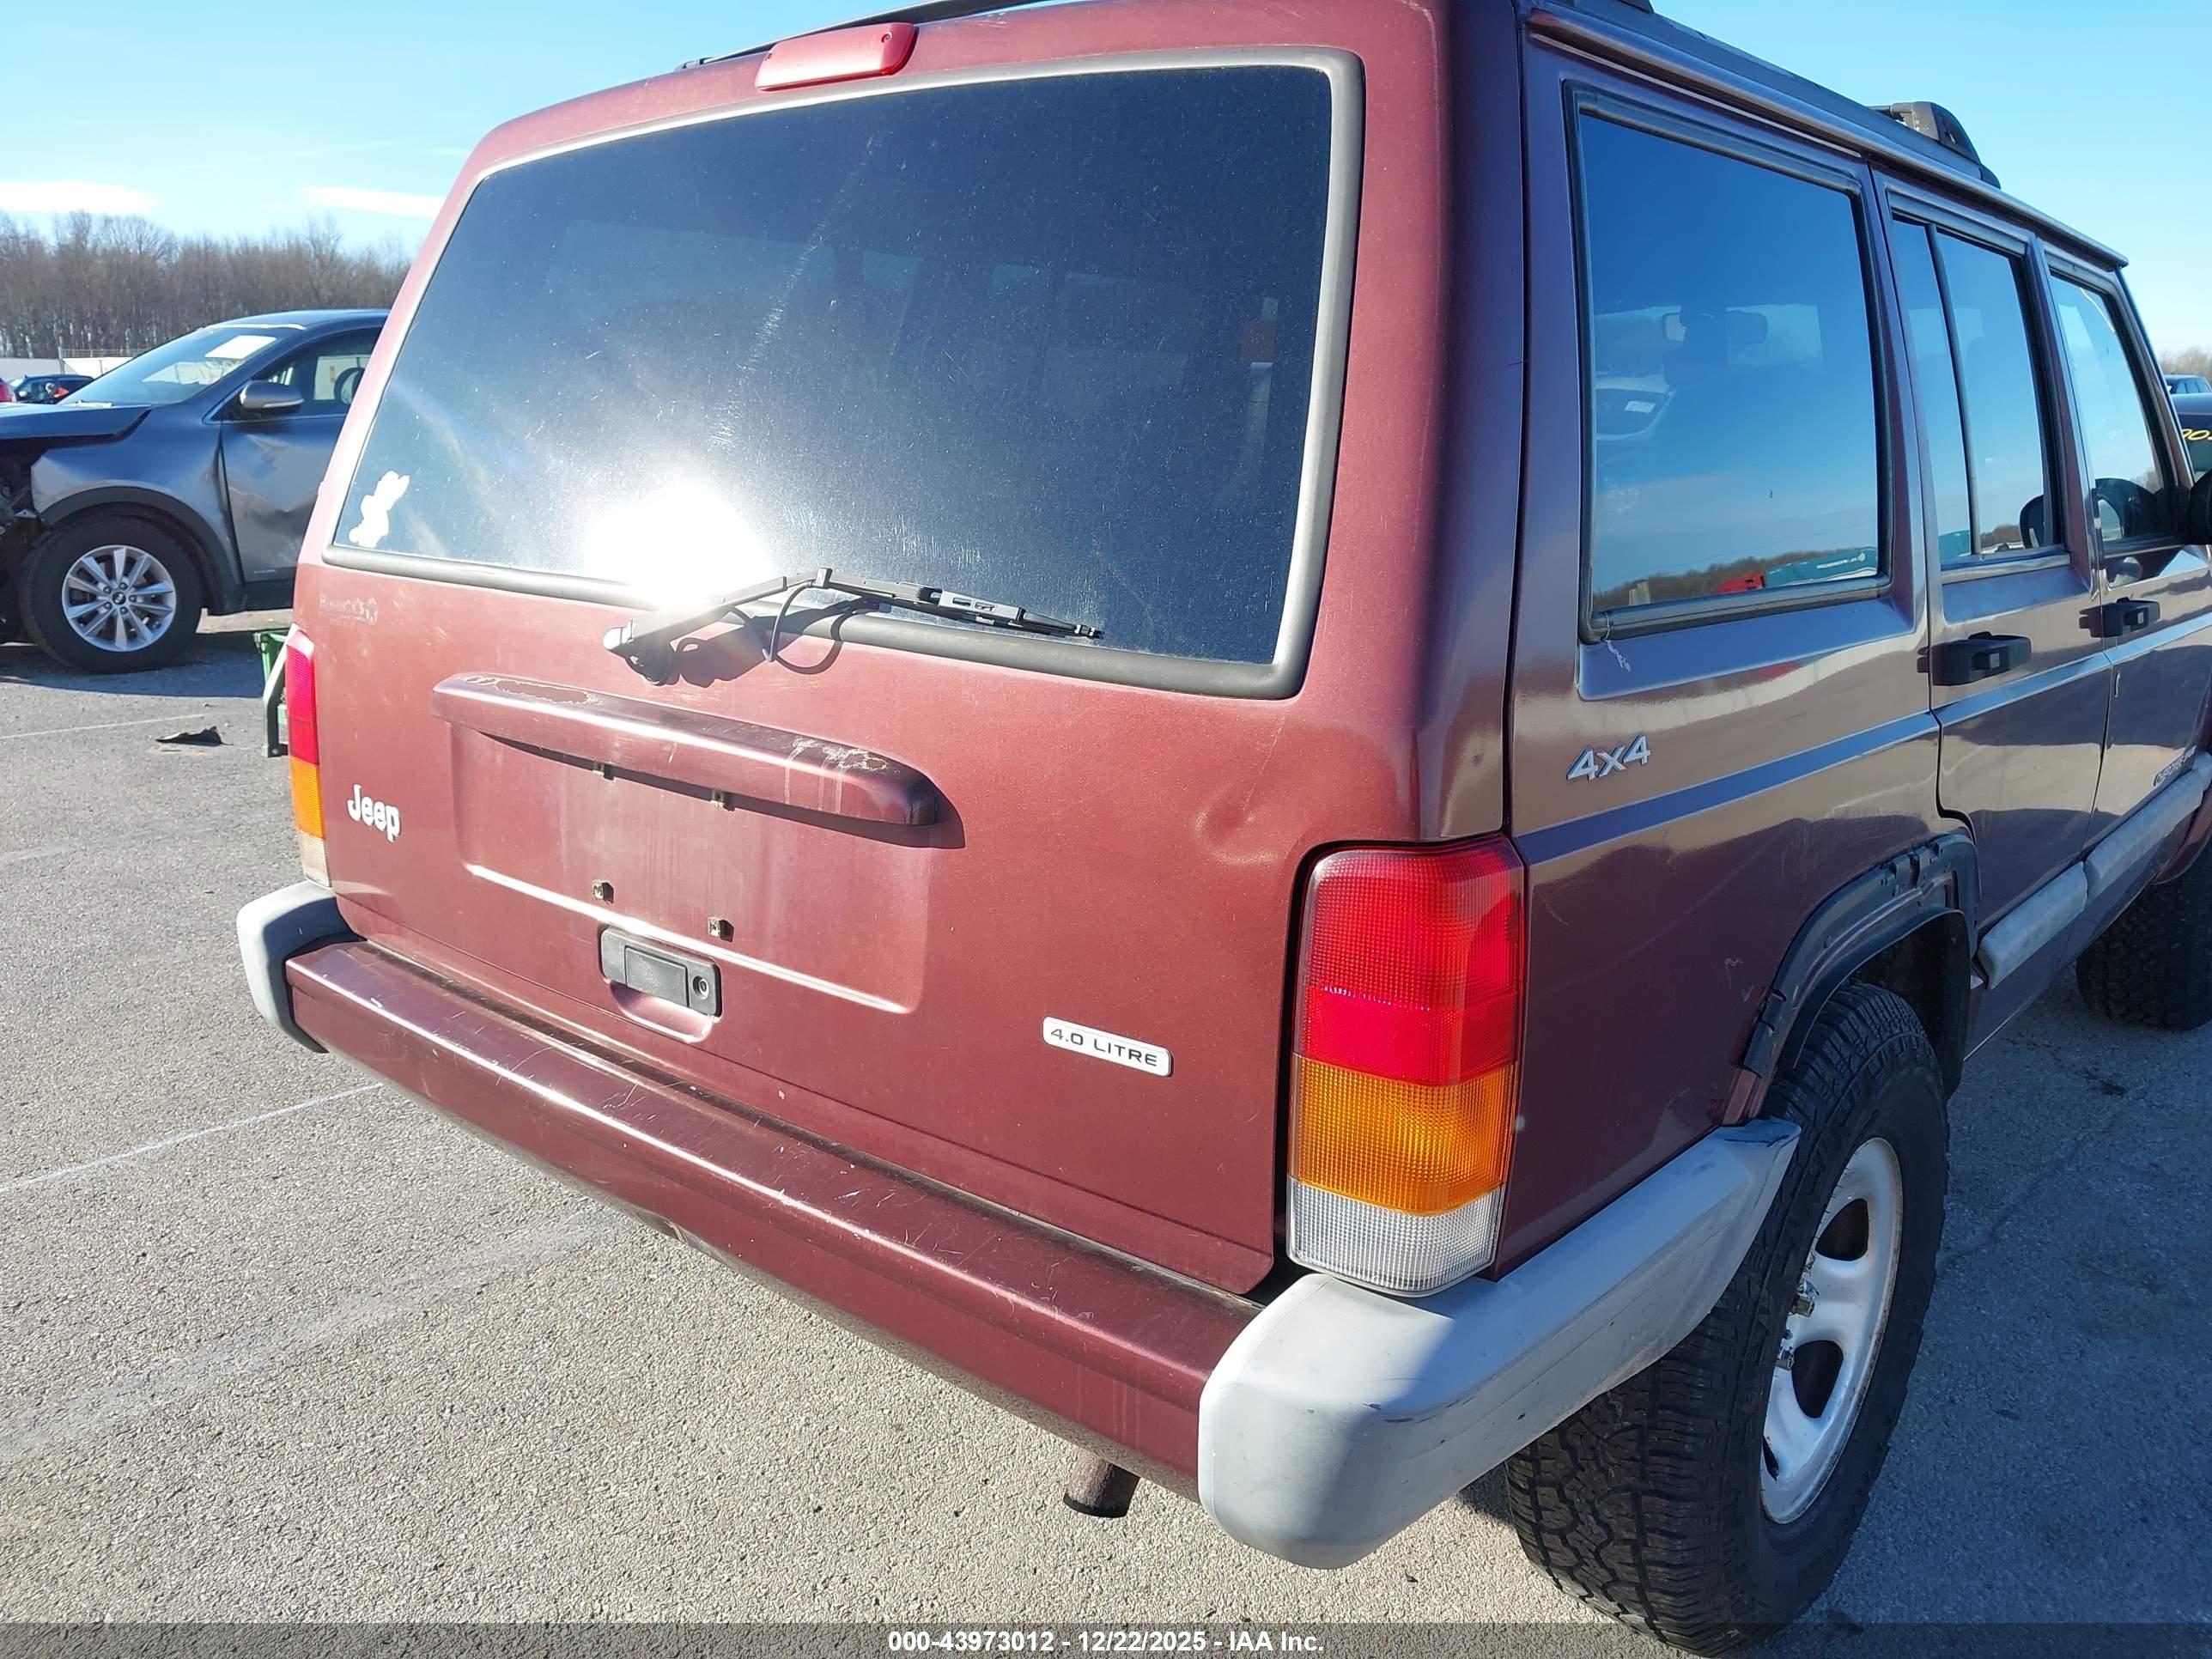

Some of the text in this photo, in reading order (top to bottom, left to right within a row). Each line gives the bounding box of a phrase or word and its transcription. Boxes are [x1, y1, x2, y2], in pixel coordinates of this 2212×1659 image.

[1566, 732, 1651, 782] 4x4
[347, 783, 401, 842] Jeep
[1050, 1028, 1158, 1066] 4.0 LITRE
